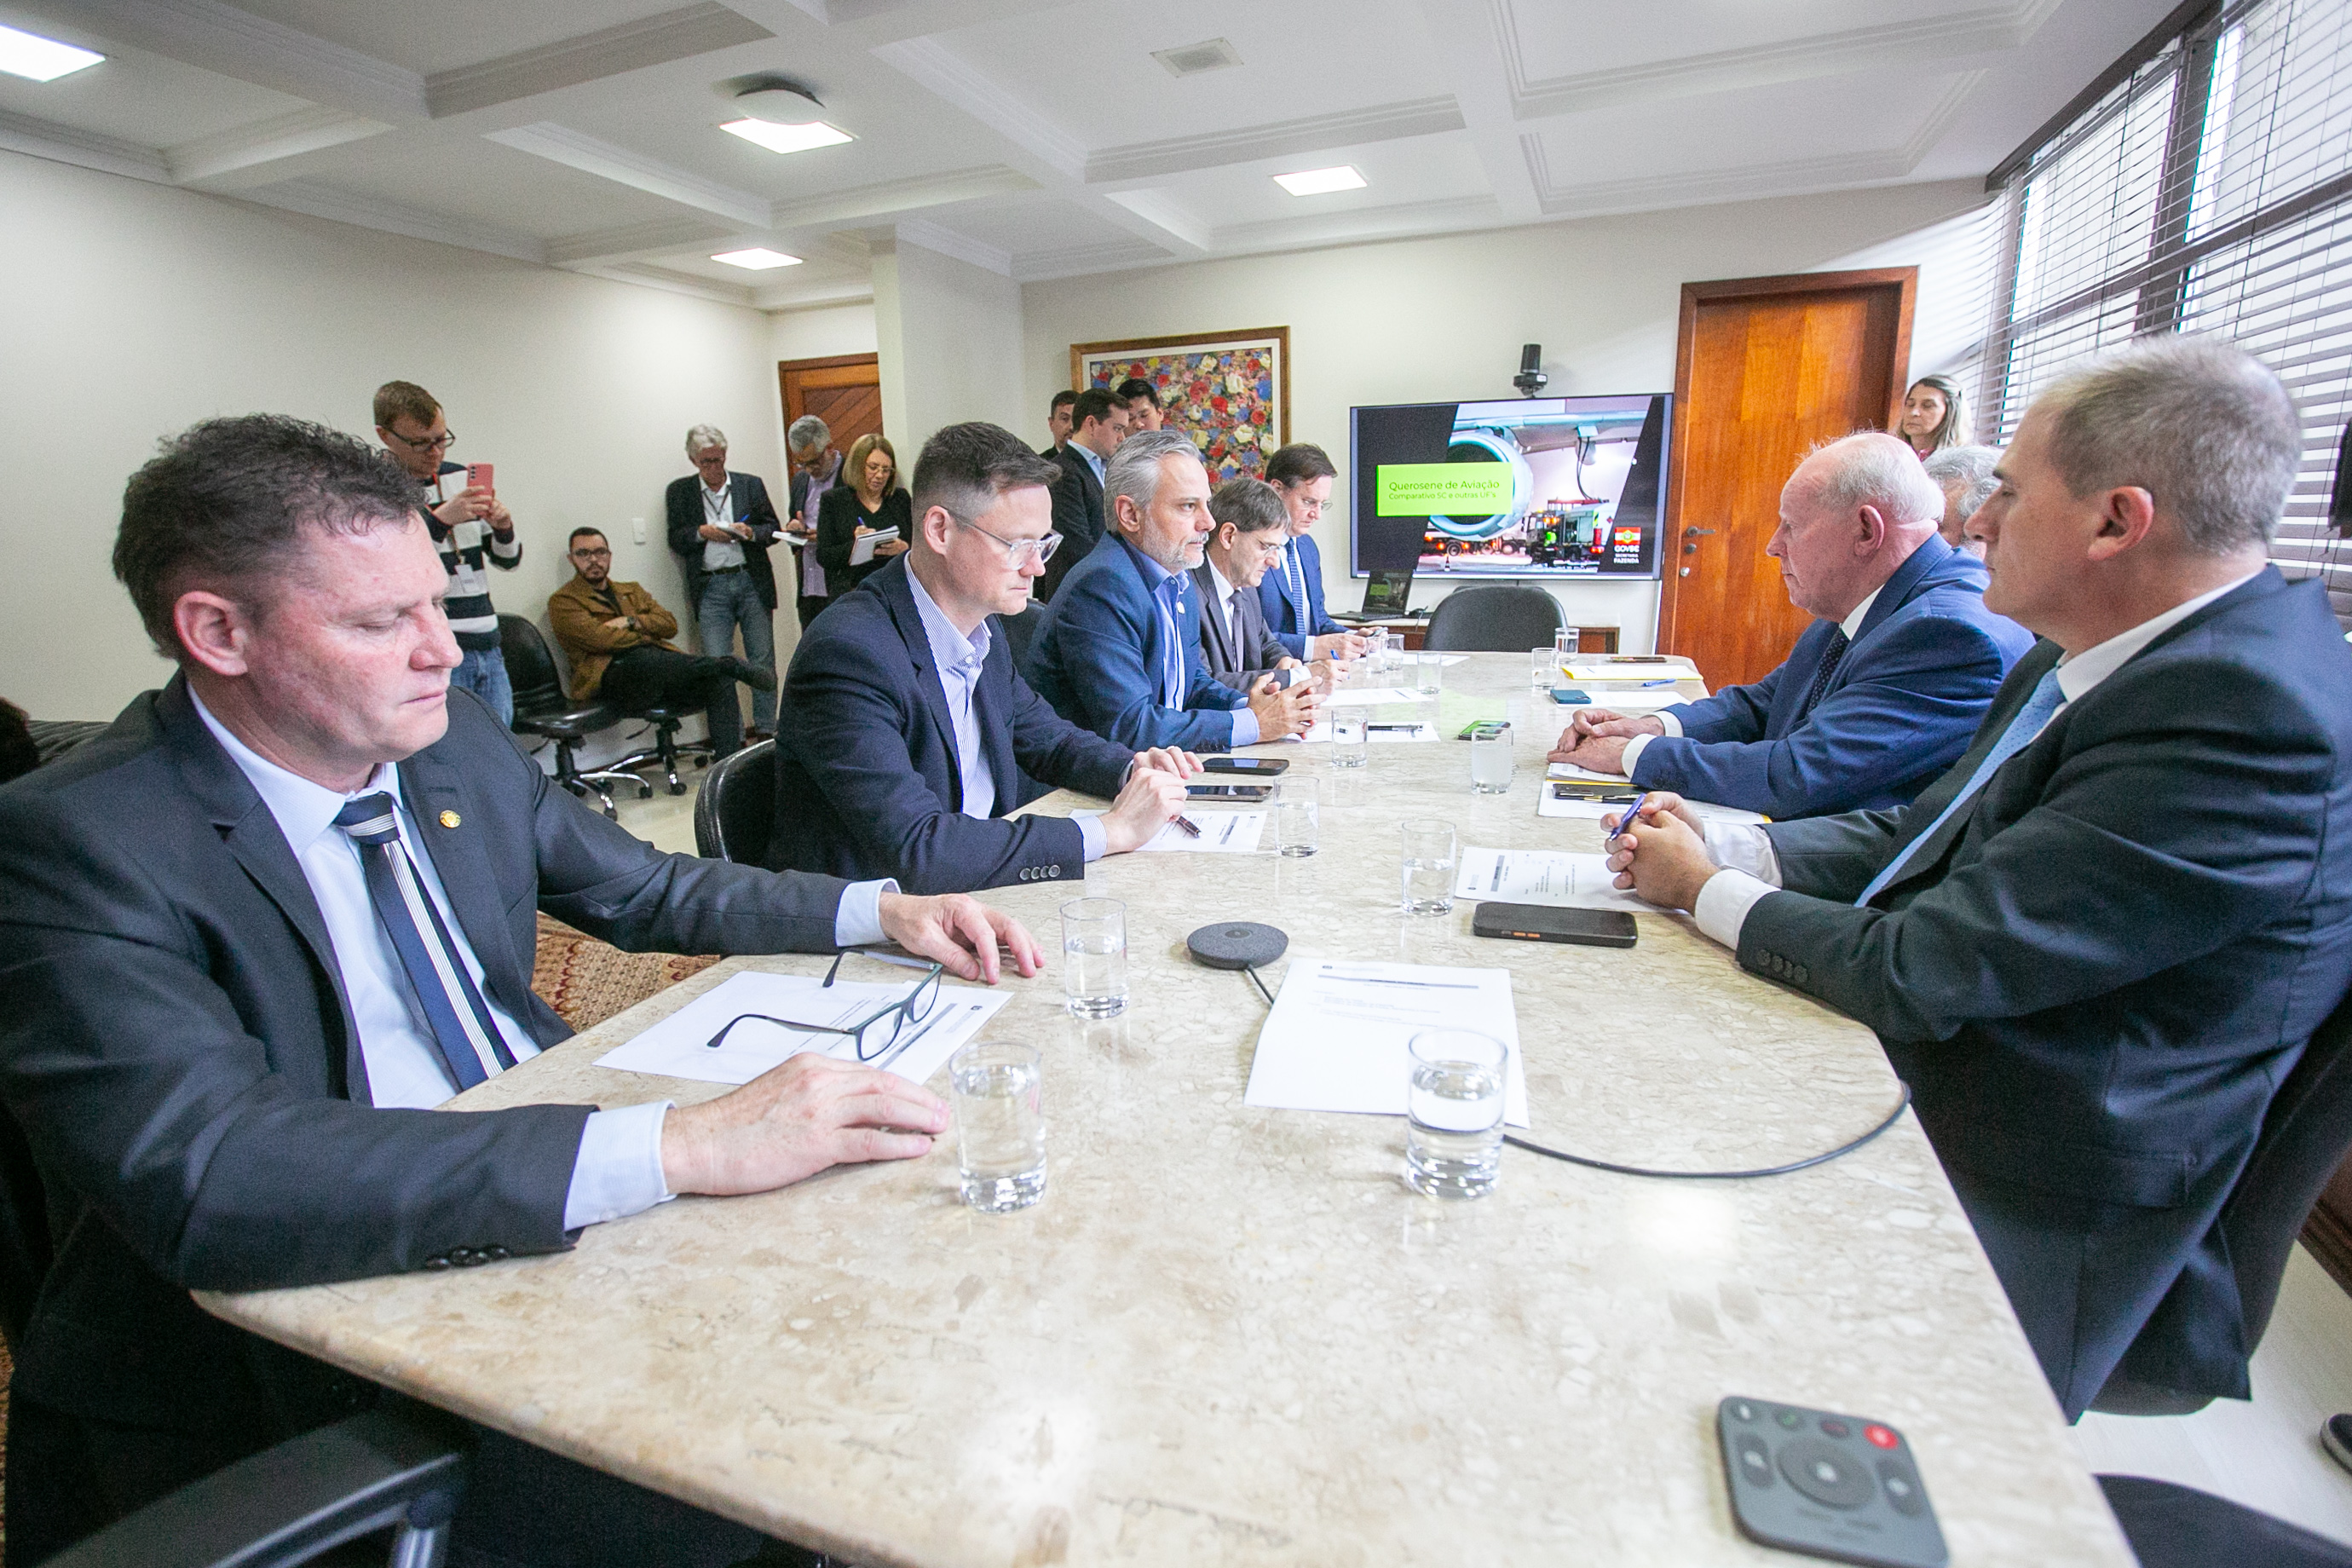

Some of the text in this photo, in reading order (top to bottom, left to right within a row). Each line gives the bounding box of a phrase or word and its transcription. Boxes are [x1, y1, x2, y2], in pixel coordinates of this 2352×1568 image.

[1389, 480, 1500, 492] Querosene de Aviação
[1389, 492, 1436, 500] Comparativo
